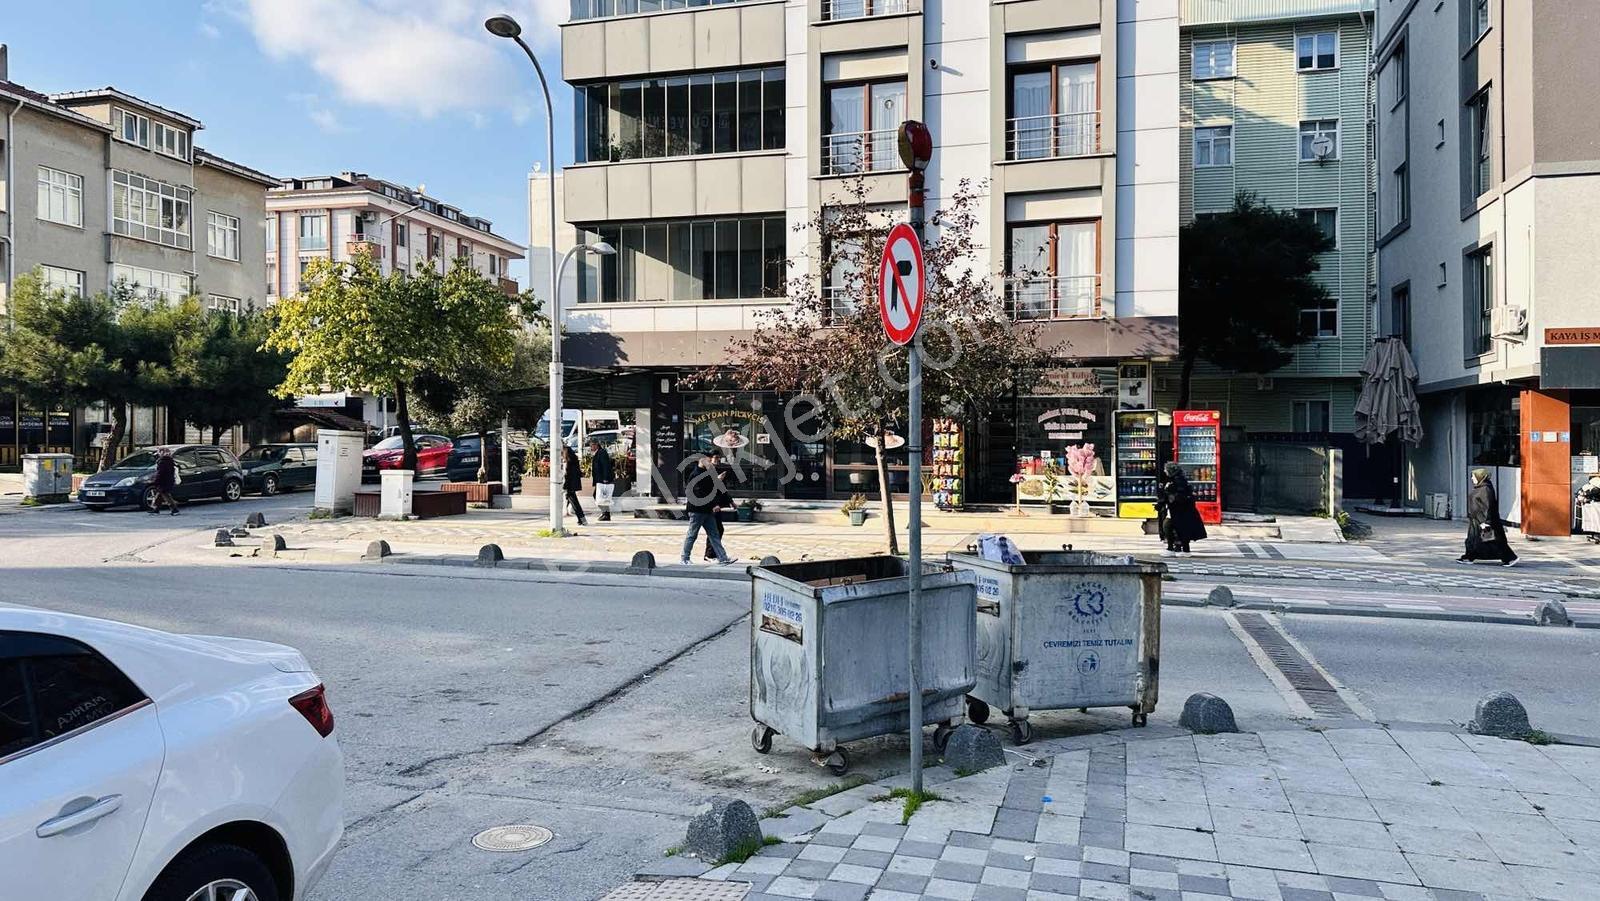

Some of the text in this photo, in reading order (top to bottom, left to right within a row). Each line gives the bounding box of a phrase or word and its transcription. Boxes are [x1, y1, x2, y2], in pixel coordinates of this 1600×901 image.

[1550, 332, 1577, 341] KAYA
[695, 411, 729, 425] MEYDAN
[1105, 638, 1134, 647] TUTALIM
